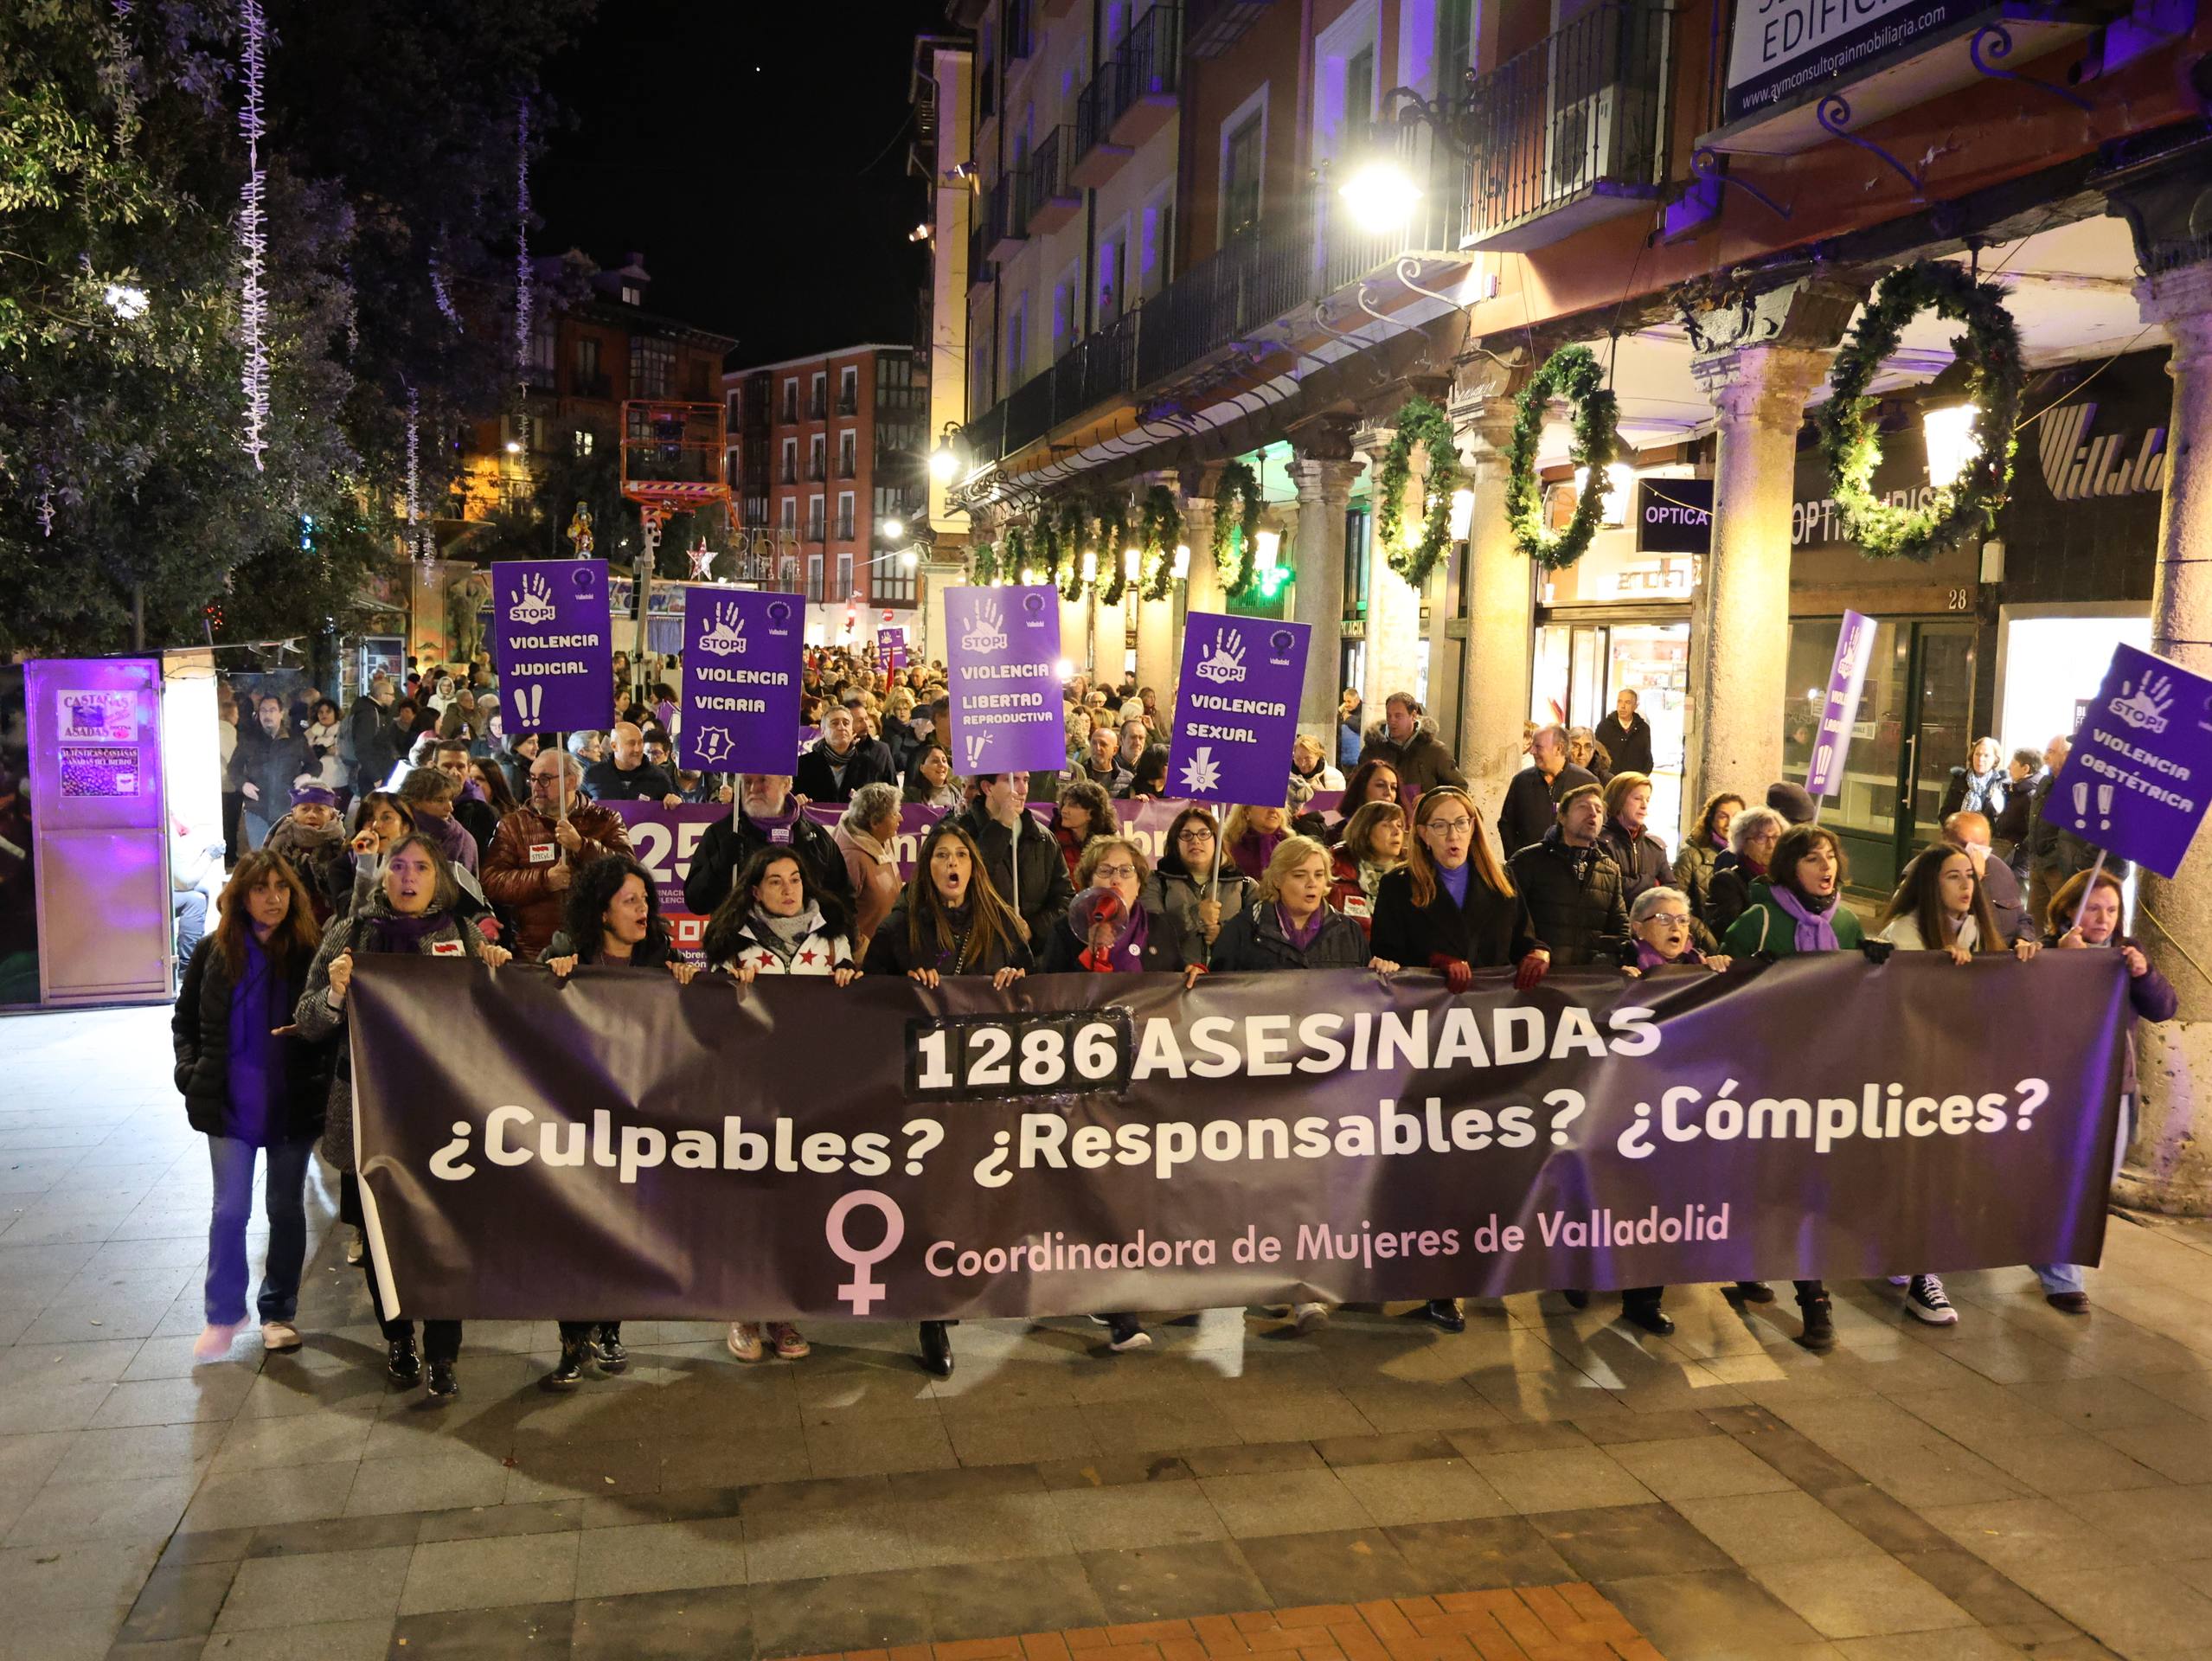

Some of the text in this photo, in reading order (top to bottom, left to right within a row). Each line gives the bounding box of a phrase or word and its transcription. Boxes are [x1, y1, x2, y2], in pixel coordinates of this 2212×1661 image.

[1742, 5, 1946, 109] www.aymconsultorainmobiliaria.com
[1645, 506, 1709, 526] OPTICA
[1948, 589, 1967, 610] 28
[512, 607, 554, 619] STOP!
[509, 634, 599, 650] VIOLENCIA
[702, 638, 744, 652] STOP!
[964, 636, 1006, 649] STOP!
[510, 662, 588, 677] JUDICIAL
[696, 667, 789, 686] VIOLENCIA
[960, 664, 1049, 680] VIOLENCIA
[1199, 664, 1244, 679] STOP!
[695, 696, 766, 713] VICARIA
[962, 693, 1043, 709] LIBERTAD
[1190, 693, 1286, 717] VIOLENCIA
[963, 711, 1054, 726] REPRODUCTIVA
[2113, 700, 2164, 732] STOP!
[65, 727, 109, 737] ASADAS
[1186, 722, 1258, 743] SEXUAL
[2093, 728, 2191, 781] VIOLENCIA
[2080, 753, 2196, 813] OBSTÉTRICA
[919, 1005, 1662, 1088] 1286 ASESINADAS
[430, 1078, 2049, 1188] ¿Culpables? ¿Responsables? ¿Cómplices?
[925, 1202, 1729, 1278] Coordinadora de Mujeres de Valladolid
